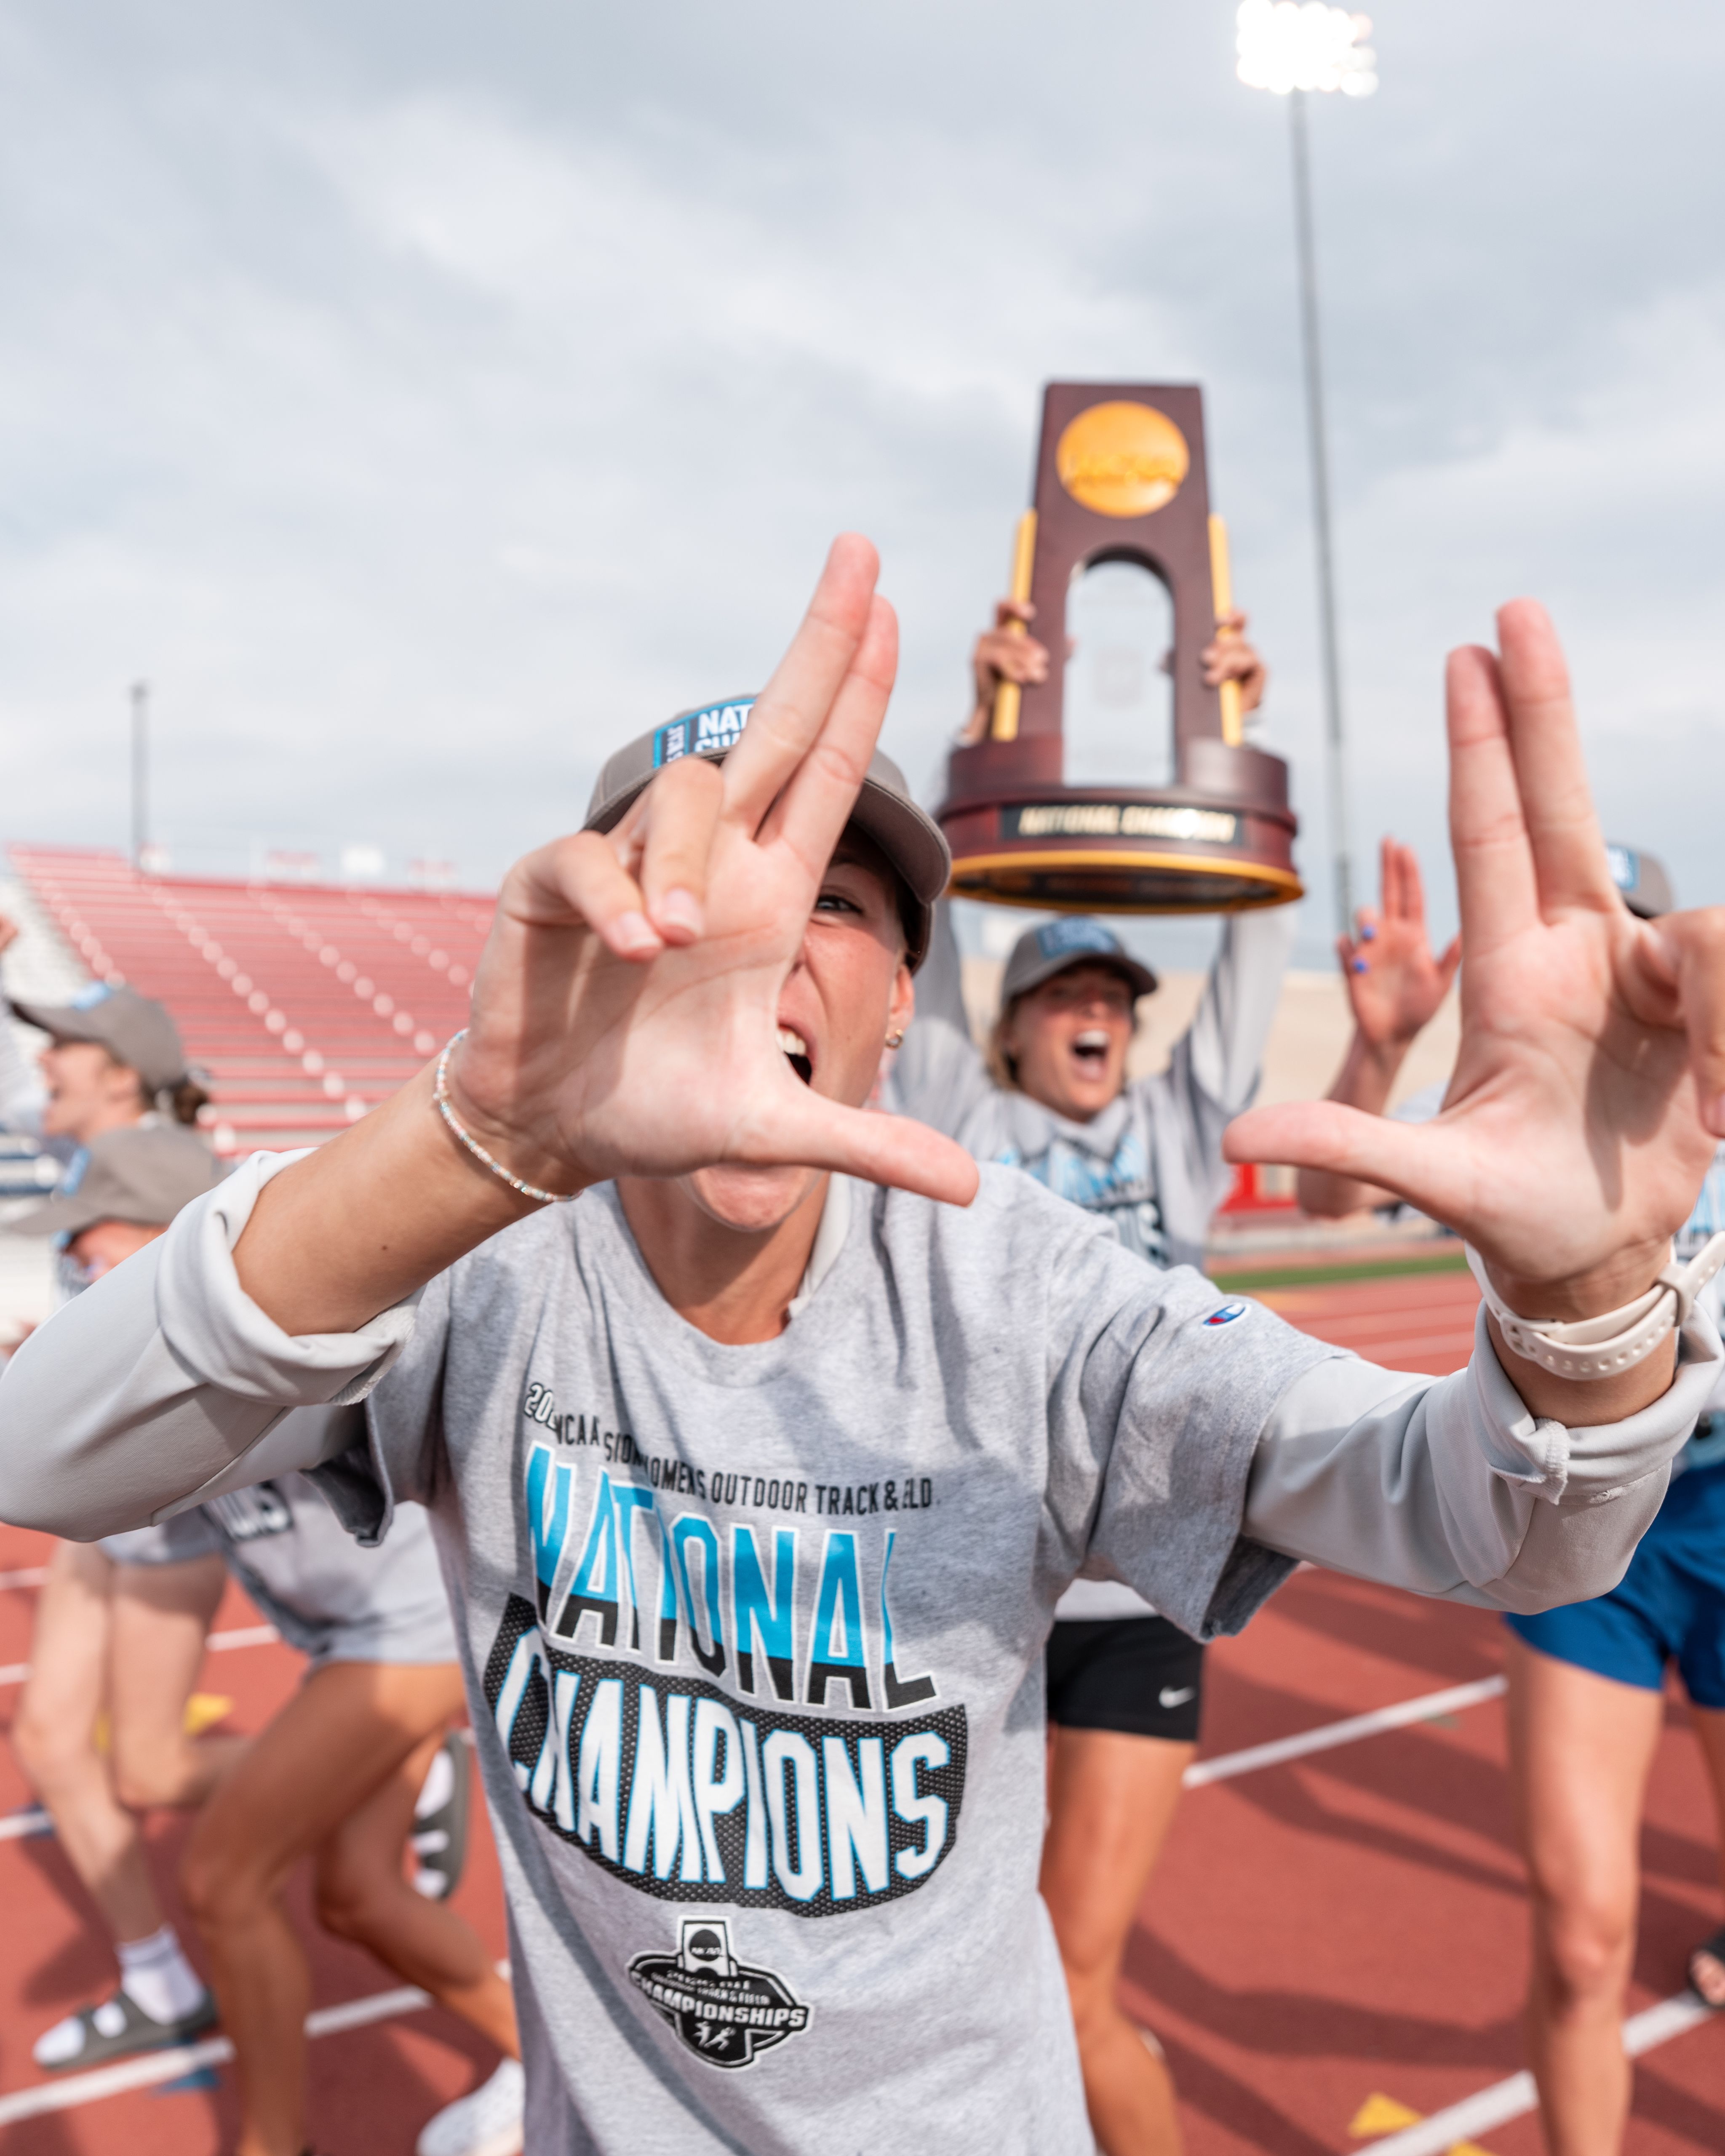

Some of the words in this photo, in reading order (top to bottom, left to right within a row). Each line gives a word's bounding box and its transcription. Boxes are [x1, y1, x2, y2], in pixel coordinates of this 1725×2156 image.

[698, 704, 754, 738] NAT
[711, 1472, 807, 1513] OUTDOOR
[815, 1482, 879, 1516] TRACK
[495, 1625, 951, 1902] CHAMPIONS
